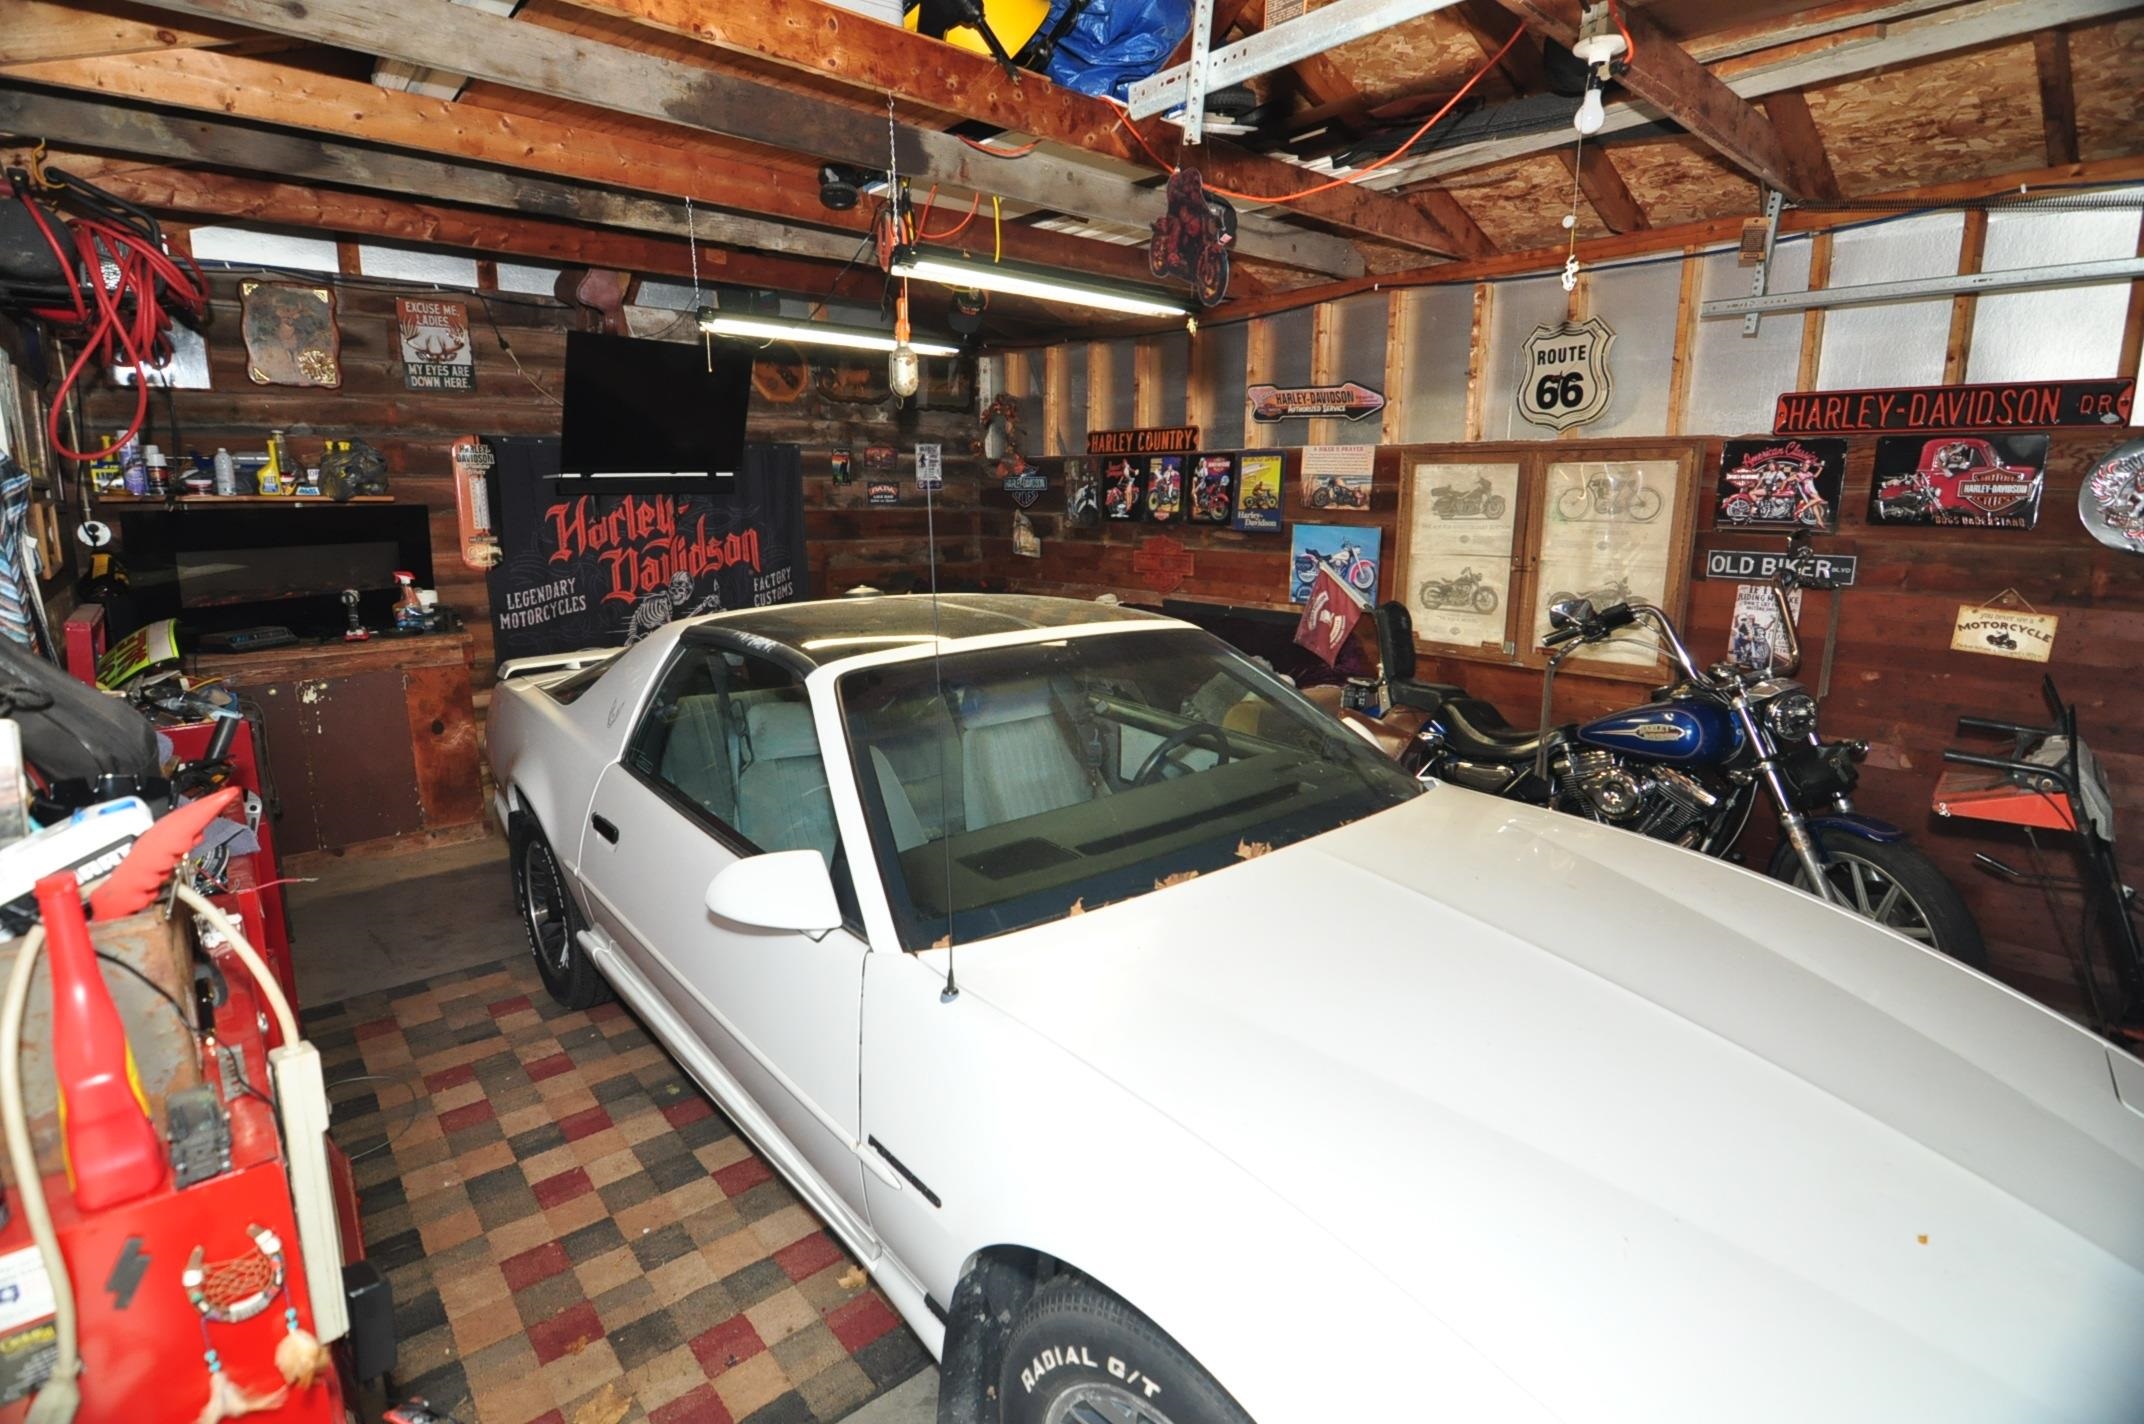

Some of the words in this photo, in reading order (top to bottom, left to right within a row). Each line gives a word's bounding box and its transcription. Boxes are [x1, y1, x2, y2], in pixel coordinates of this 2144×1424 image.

[405, 302, 440, 314] EXCUSE
[1537, 345, 1586, 365] ROUTE
[408, 364, 423, 375] MY
[425, 365, 449, 377] EYES
[452, 366, 470, 377] ARE
[411, 376, 441, 387] DOWN
[444, 377, 472, 389] HERE.
[1536, 371, 1584, 410] 66
[1275, 391, 1354, 405] HARLEY-DAVIDSON
[1787, 387, 2061, 430] HARLEY-DAVIDSON
[2080, 394, 2112, 415] DR
[1091, 432, 1134, 452] HARLEY
[1137, 428, 1193, 450] COUNTRY
[1963, 484, 2028, 494] HARLEY-DAVIDSON
[1711, 555, 1754, 574] OLD
[753, 566, 792, 592] FACTORY
[506, 577, 577, 610] LEGENDARY
[753, 581, 794, 607] CUSTOMS
[500, 595, 587, 630] MOTORCYCLES
[1957, 621, 2053, 643] MOTORCYCLE
[1020, 1345, 1098, 1394] RADIAL
